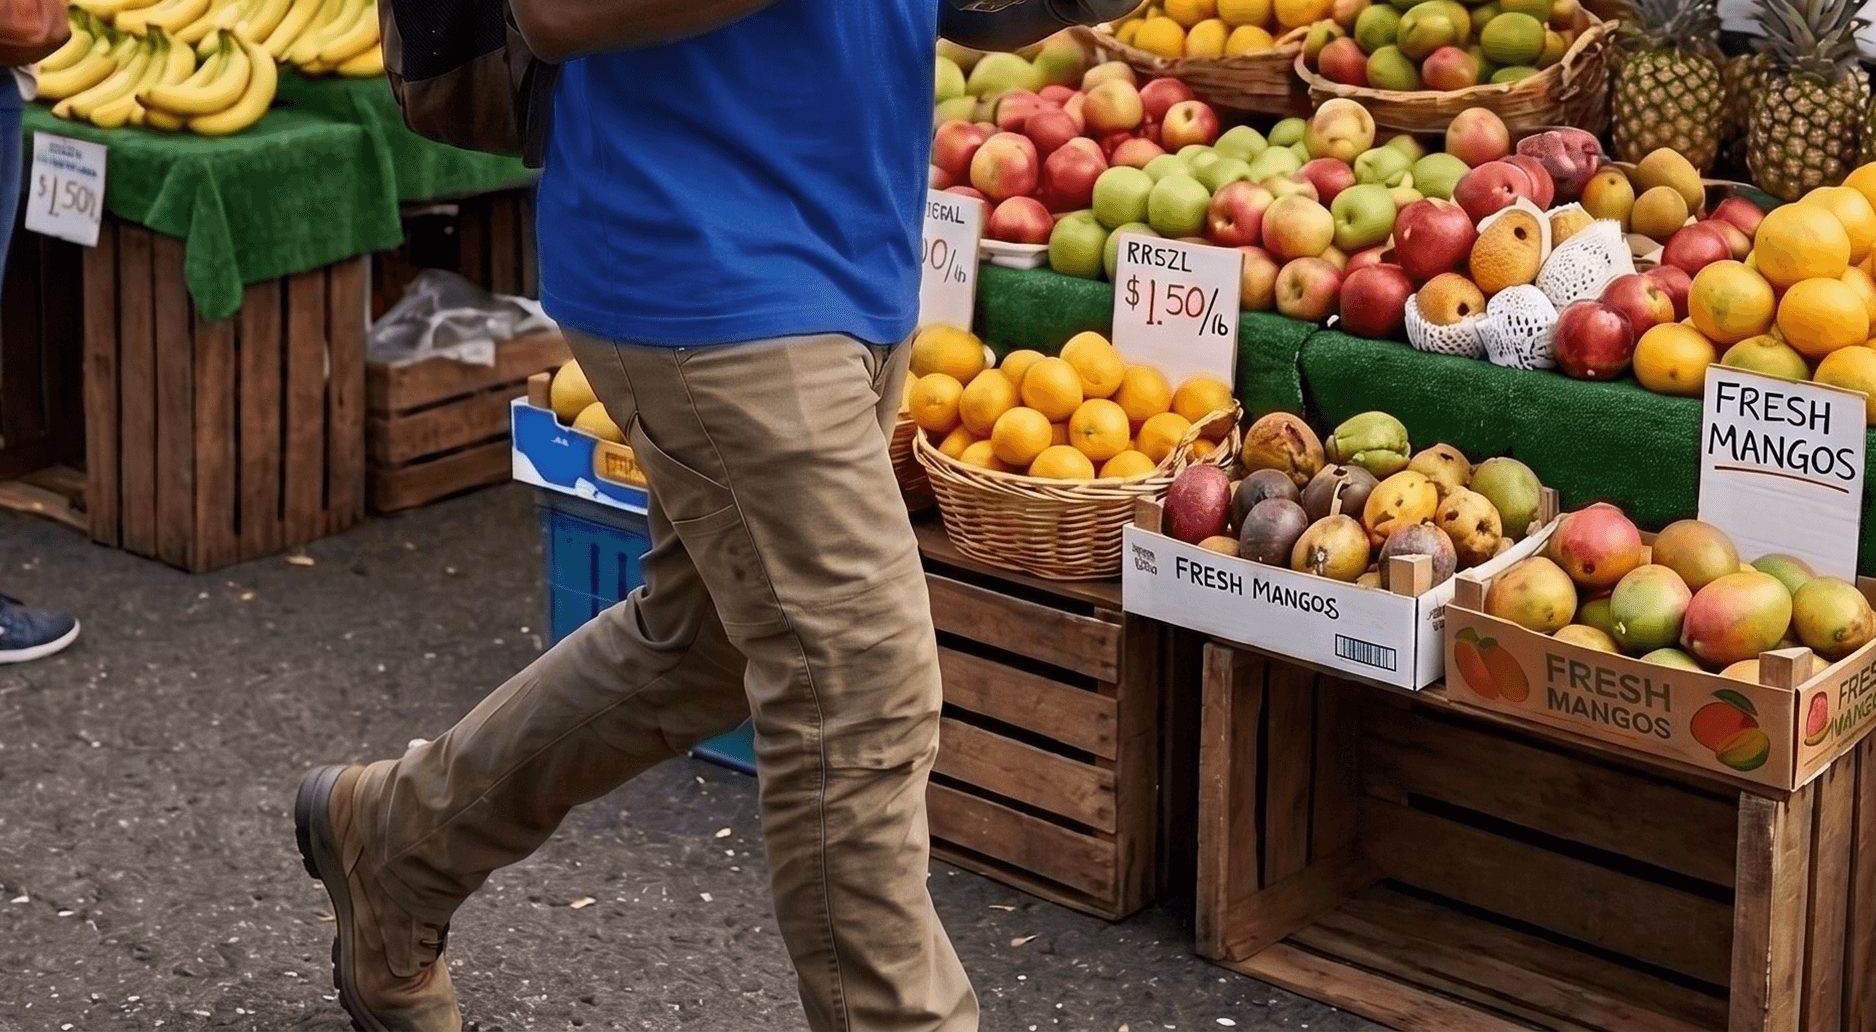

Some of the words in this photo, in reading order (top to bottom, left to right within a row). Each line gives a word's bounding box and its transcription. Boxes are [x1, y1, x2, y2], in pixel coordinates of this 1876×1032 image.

[1127, 241, 1192, 273] RRSZL
[1716, 381, 1831, 435] FRESH
[1708, 422, 1856, 481] MANGOS
[1175, 556, 1243, 596] FRESH
[1252, 578, 1340, 620] MANGOS
[1546, 652, 1671, 712] FRESH
[1547, 686, 1672, 740] MANGOS
